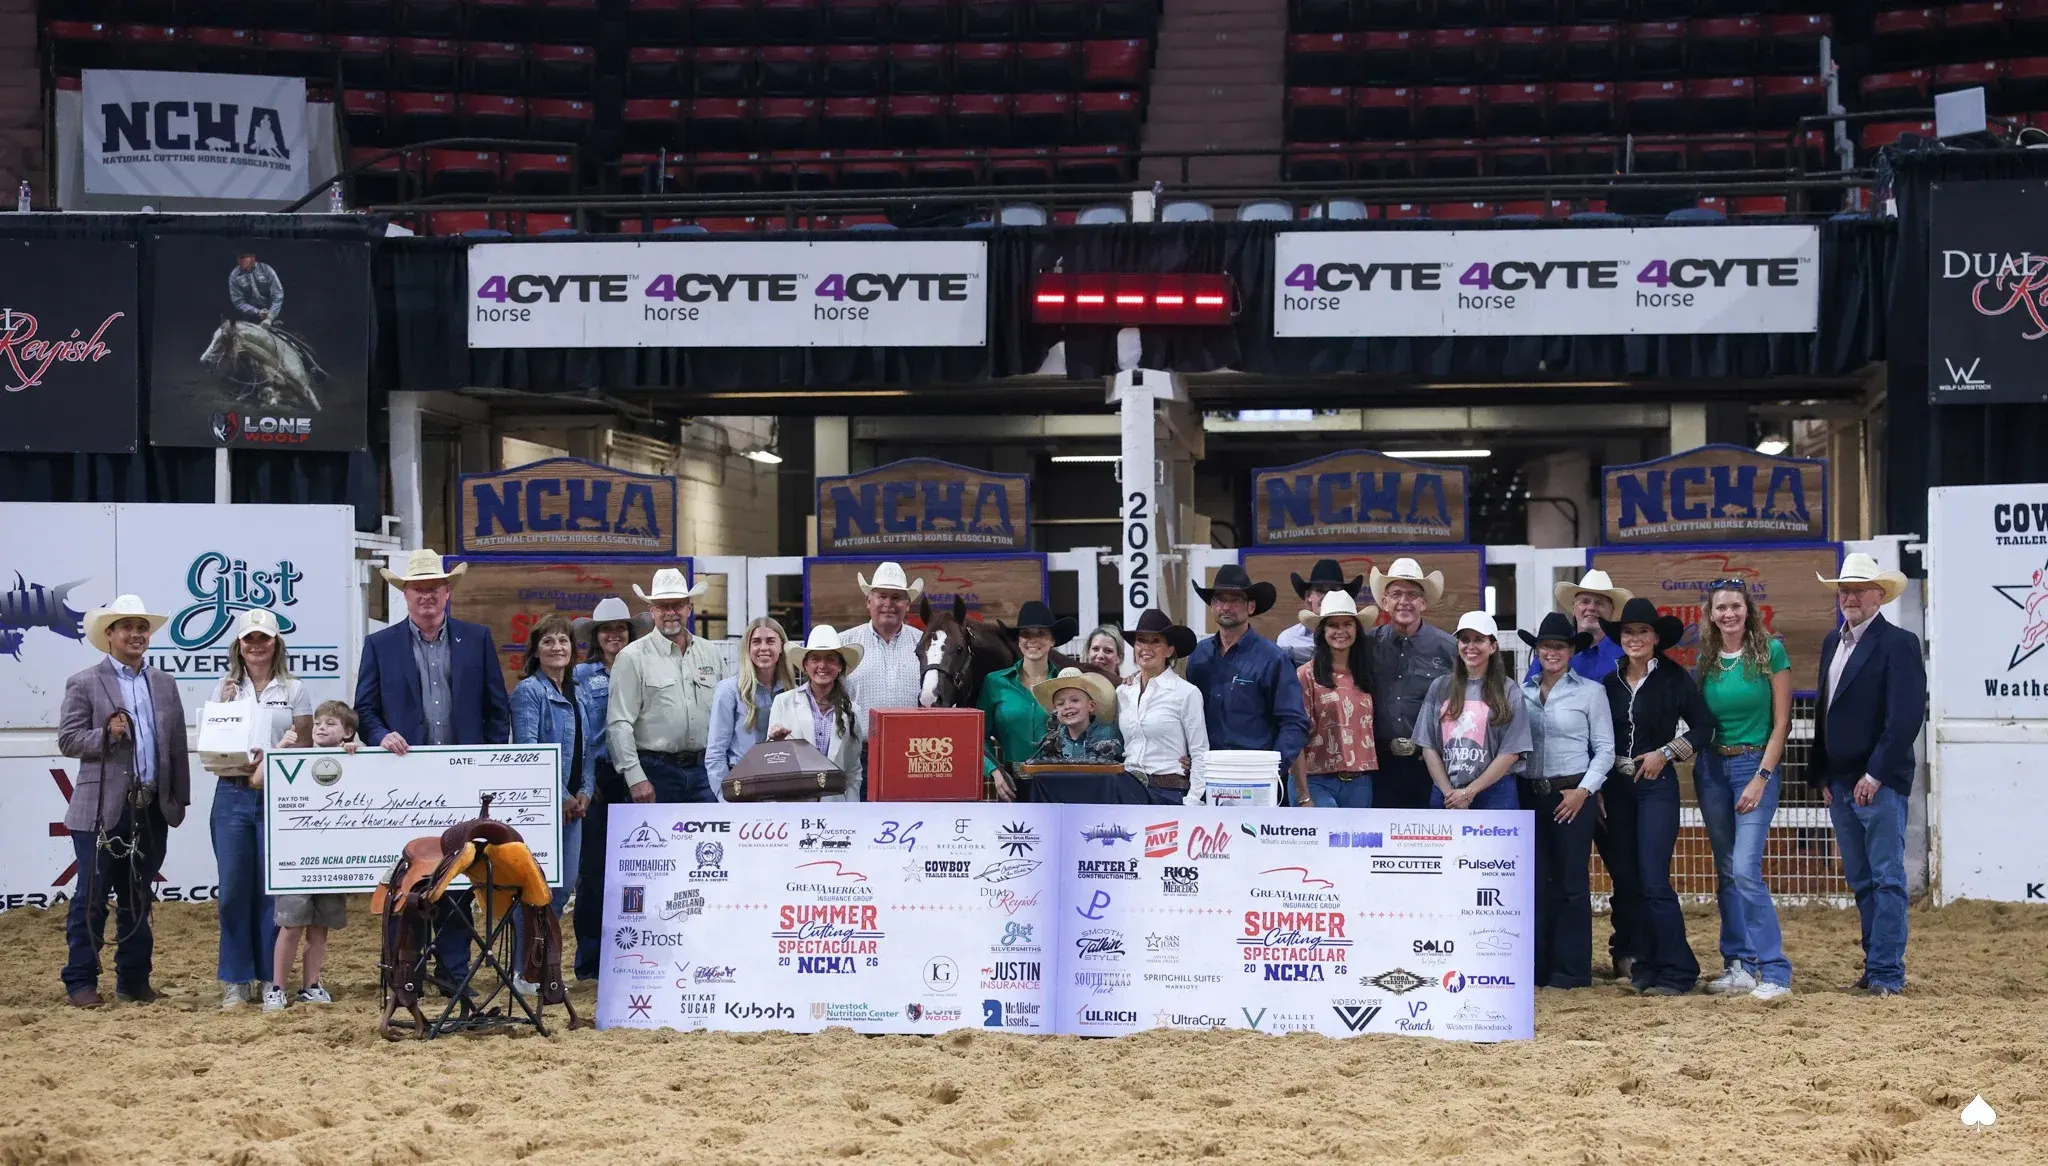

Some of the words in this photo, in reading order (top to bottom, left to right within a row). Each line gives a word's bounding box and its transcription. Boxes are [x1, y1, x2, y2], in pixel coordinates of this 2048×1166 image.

[101, 101, 290, 159] NCHA
[103, 154, 151, 165] NATIONAL
[153, 154, 195, 163] CUTTING
[197, 154, 228, 164] HORSE
[230, 157, 292, 171] ASSOCIATION
[1942, 250, 2037, 278] DUAL
[1284, 294, 1340, 310] horse
[1458, 293, 1515, 309] horse
[1636, 290, 1694, 307] horse
[476, 305, 531, 323] horse
[643, 303, 699, 321] horse
[814, 303, 869, 321] horse
[244, 416, 311, 433] LONE
[245, 433, 310, 443] WOOLF
[1265, 471, 1453, 529] NCHA
[1617, 465, 1810, 529] NCHA
[473, 479, 660, 538] NCHA
[830, 480, 1014, 540] NCHA
[1269, 529, 1315, 540] NATIONAL
[1318, 526, 1358, 535] CUTTING
[1360, 526, 1388, 534] HORSE
[1391, 526, 1450, 536] ASSOCIATION
[1620, 524, 1668, 538] NATIONAL
[1670, 521, 1711, 531] CUTTING
[1714, 520, 1744, 529] HORSE
[1746, 521, 1808, 532] ASSOCIATION
[476, 536, 525, 546] NATIONAL
[569, 535, 599, 543] HORSE
[600, 536, 660, 547] ASSOCIATION
[835, 535, 881, 547] NATIONAL
[883, 534, 923, 543] CUTTING
[925, 533, 954, 541] HORSE
[955, 534, 1013, 545] ASSOCIATION
[1995, 536, 2047, 545] TRAILER
[1128, 492, 1149, 608] 2026
[169, 550, 303, 651] Gist
[905, 737, 953, 758] RIOS
[490, 753, 540, 763] 7-18-2026
[908, 757, 953, 773] MERCEDES
[1260, 825, 1317, 836] Nutrena
[1390, 823, 1452, 835] PLATINUM
[1462, 825, 1518, 836] Priefert
[1145, 831, 1178, 847] MVP
[300, 857, 319, 865] 2026
[322, 856, 343, 865] NCHA
[346, 856, 366, 864] OPEN
[369, 855, 399, 863] CLASSIC
[619, 859, 676, 871] BRUMBAUGH'S
[925, 861, 971, 872] COWBOY
[1078, 861, 1125, 872] RAFTER
[1372, 861, 1394, 869] PRO
[1398, 861, 1441, 869] CUTTER
[1459, 859, 1516, 870] PulseVet
[1161, 867, 1199, 883] RIOS
[674, 889, 700, 900] DENNIS
[980, 888, 1008, 897] DUAL
[1163, 882, 1199, 893] MERCEDES
[666, 897, 705, 911] MORELAND
[780, 905, 877, 930] SUMMER
[1245, 911, 1345, 937] SUMMER
[641, 930, 683, 946] Frost
[798, 921, 856, 943] Cutting
[1001, 921, 1034, 946] Gist
[1082, 928, 1123, 938] SMOOTH
[1264, 928, 1324, 950] Cutting
[778, 940, 878, 954] SPECTACULAR
[1076, 937, 1125, 959] Talkin
[1244, 947, 1346, 961] SPECTACULAR
[778, 957, 790, 966] 20
[798, 957, 856, 973] NCHA
[866, 957, 878, 967] 26
[990, 961, 1041, 981] JUSTIN
[1075, 972, 1103, 985] SOUTH
[1244, 964, 1256, 972] 20
[1264, 964, 1324, 981] NCHA
[1335, 965, 1347, 974] 26
[980, 981, 1040, 989] INSURANCE
[1467, 976, 1515, 985] TOML
[681, 1003, 716, 1014] SUGAR
[725, 1002, 795, 1019] Kubota
[827, 1002, 868, 1010] Livestock
[827, 1009, 868, 1017] Nutrition
[925, 1007, 961, 1015] LONE
[1005, 1002, 1040, 1014] McAlister
[1005, 1015, 1029, 1027] Assets
[1086, 1010, 1137, 1022] ULRICH
[1172, 1014, 1226, 1025] UltraCruz
[1395, 1018, 1434, 1031] Ranch
[1475, 1023, 1513, 1031] Bloodstock
